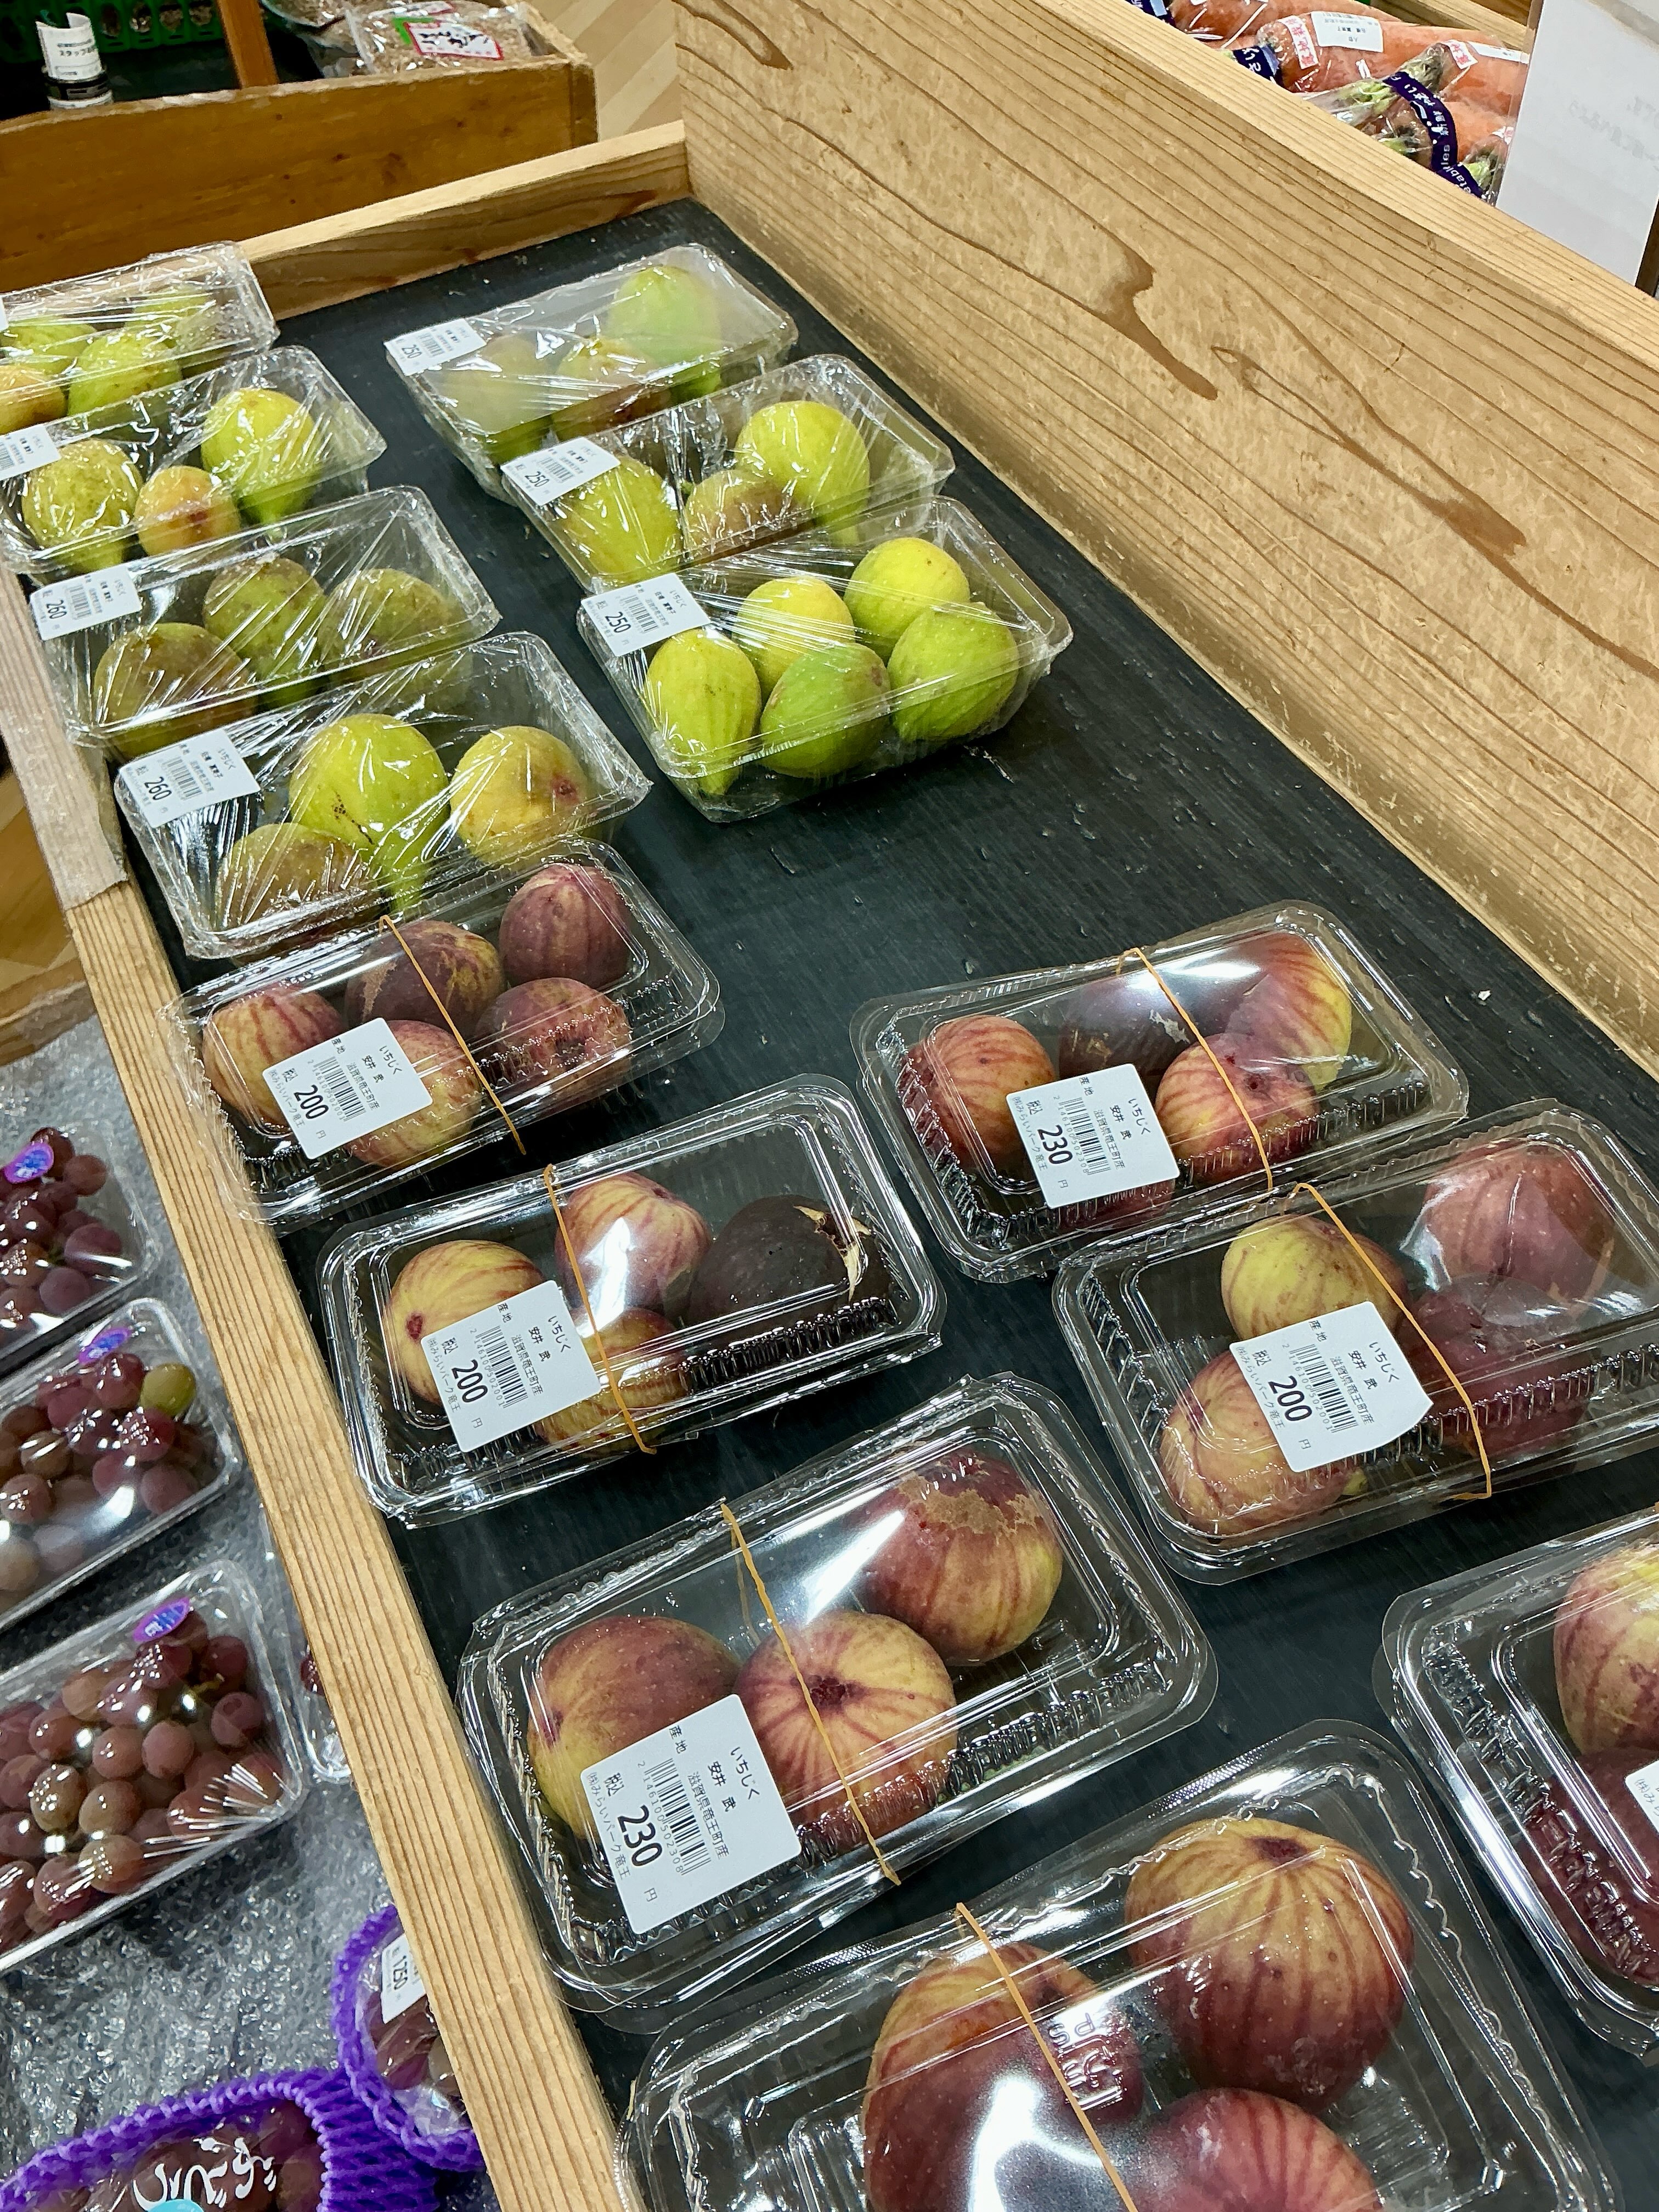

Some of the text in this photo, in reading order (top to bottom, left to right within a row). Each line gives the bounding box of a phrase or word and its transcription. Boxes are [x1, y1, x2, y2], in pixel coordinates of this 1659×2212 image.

[402, 344, 422, 359] 250
[524, 471, 550, 487] 250
[46, 599, 67, 619] 260
[605, 611, 631, 633] 250
[144, 776, 172, 800] 260
[379, 1045, 403, 1075] いちじく
[294, 1084, 329, 1119] 200
[1109, 1105, 1125, 1122] 安井
[1128, 1098, 1151, 1135] いちじく
[1037, 1124, 1073, 1164] 230
[528, 1326, 544, 1344] 安井
[548, 1316, 571, 1353] いちじく
[451, 1359, 488, 1403] 200
[1308, 1320, 1374, 1425] 産地 滋賀県竜王町産
[1348, 1350, 1378, 1390] 安井 武
[1369, 1342, 1400, 1383] いちじく
[1268, 1375, 1313, 1421] 200
[1298, 1438, 1312, 1450] 円
[669, 1725, 730, 1859] 産地 滋賀県竜王町産
[707, 1760, 736, 1812] 安井 武
[730, 1747, 760, 1800] いちじく
[617, 1804, 663, 1866] 230
[644, 1887, 658, 1902] 円
